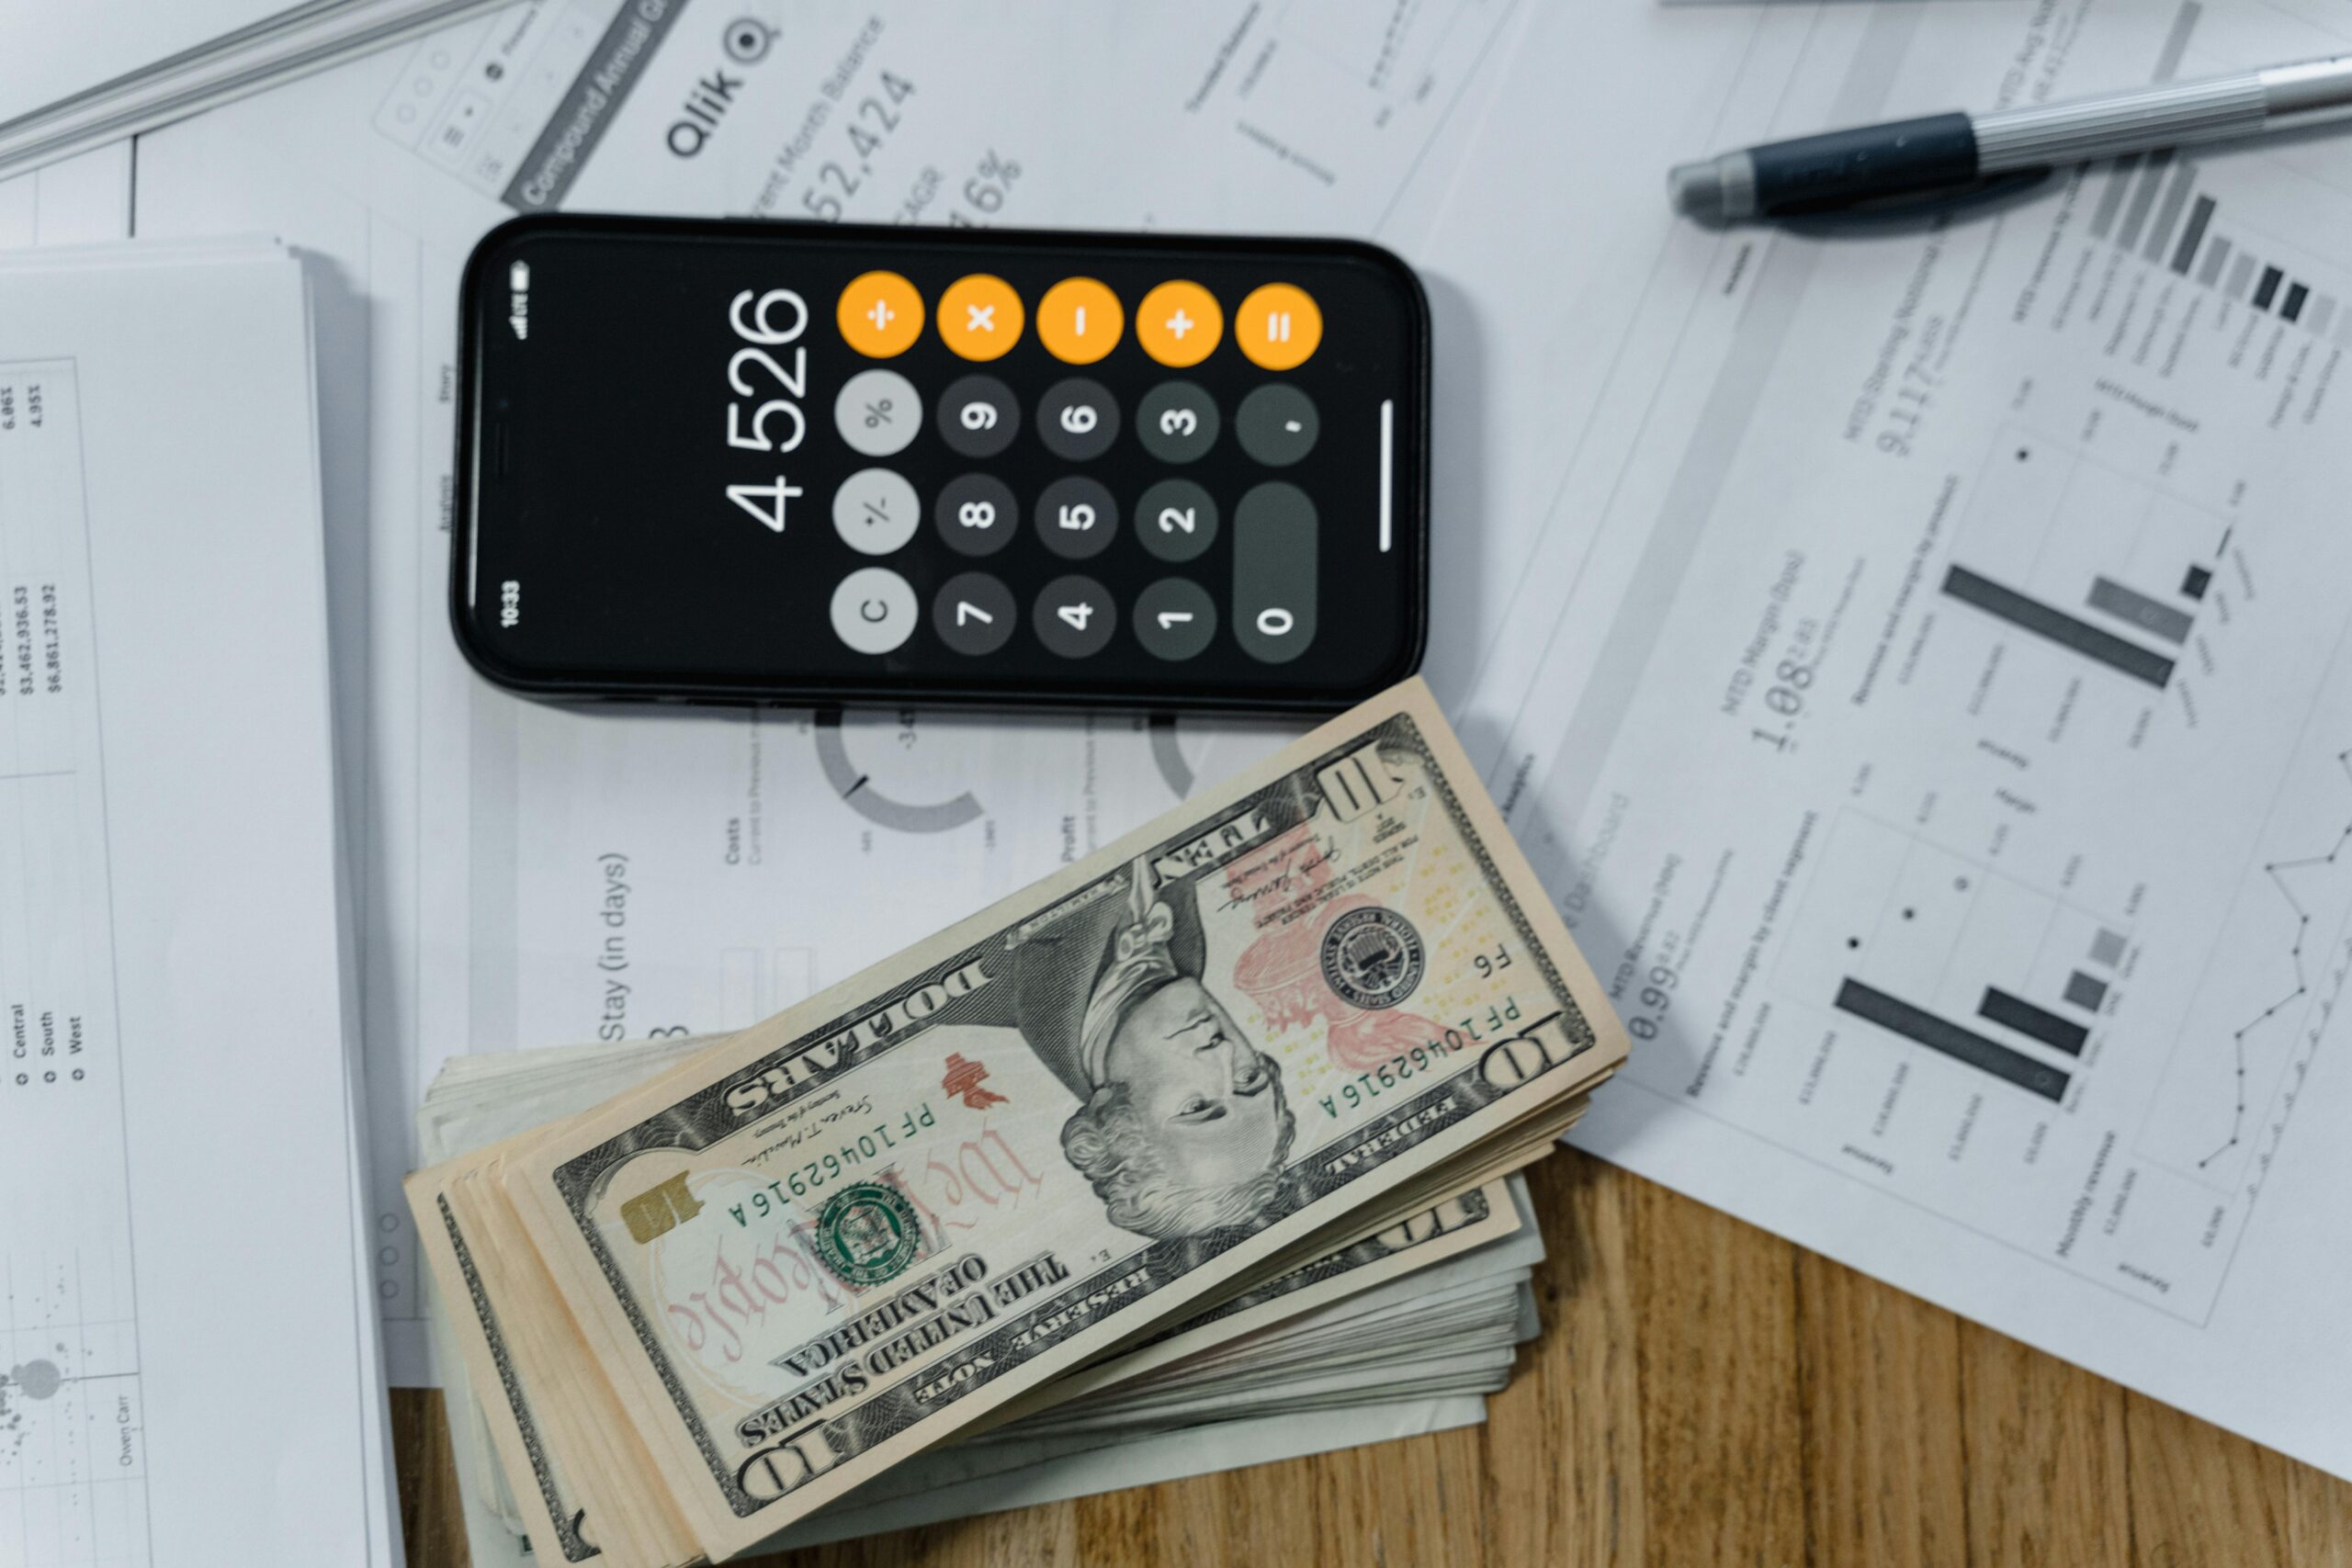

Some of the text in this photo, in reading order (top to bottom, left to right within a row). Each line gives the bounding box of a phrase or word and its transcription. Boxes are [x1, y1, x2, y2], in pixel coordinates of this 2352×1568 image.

[514, 81, 612, 212] Compound
[589, 14, 654, 97] Annual
[665, 70, 744, 160] Qlik
[775, 99, 832, 172] Month
[820, 14, 886, 102] Balance
[28, 385, 42, 427] 4.95%
[865, 399, 893, 428] %
[961, 402, 997, 429] 9
[1061, 406, 1097, 433] 6
[1160, 410, 1196, 435] 3
[1875, 360, 1945, 458] 9.117
[959, 502, 995, 528] 8
[1059, 504, 1095, 530] 5
[1159, 508, 1194, 533] 2
[1925, 473, 1961, 540] product
[1915, 536, 1936, 558] by
[501, 581, 519, 627] 10:33
[861, 601, 888, 623] C
[957, 602, 992, 626] 7
[1894, 555, 1926, 612] margin
[41, 585, 62, 693] $6,861,278.92
[1057, 603, 1092, 630] 4
[1158, 613, 1193, 628] 1
[1257, 608, 1293, 635] 0
[1882, 609, 1903, 643] and
[1720, 668, 1755, 716] MTD
[1740, 602, 1782, 669] Margin
[1850, 639, 1890, 707] Revenue
[1751, 659, 1815, 752] 1.08
[1313, 738, 1410, 827] 10
[725, 818, 741, 865] Costs
[1060, 816, 1076, 863] Profit
[1142, 804, 1272, 892] TEN
[1560, 792, 1630, 916] Dashboard
[597, 852, 631, 1043] Stay (in days)
[1468, 942, 1513, 980] F6
[1620, 896, 1664, 964] Revenue
[1682, 1032, 1724, 1100] Revenue
[1717, 999, 1738, 1032] and
[1729, 939, 1762, 1001] margin
[1750, 924, 1772, 943] by
[1762, 878, 1790, 924] client
[1781, 810, 1819, 878] segment
[11, 1004, 26, 1058] Central
[40, 1011, 55, 1056] South
[1624, 965, 1679, 1042] 0.99
[69, 1017, 83, 1055] West
[719, 954, 995, 1120] DOLLARS
[616, 1168, 709, 1247] 10
[2054, 1130, 2117, 1259] Monthly revenue
[730, 1008, 1585, 1508] 10 FEDERAL RESERVE NOTE 10
[768, 1249, 991, 1388] OF AMERICA
[731, 1250, 1070, 1453] THE UNITED STATES
[117, 1395, 136, 1466] Owen Carr
